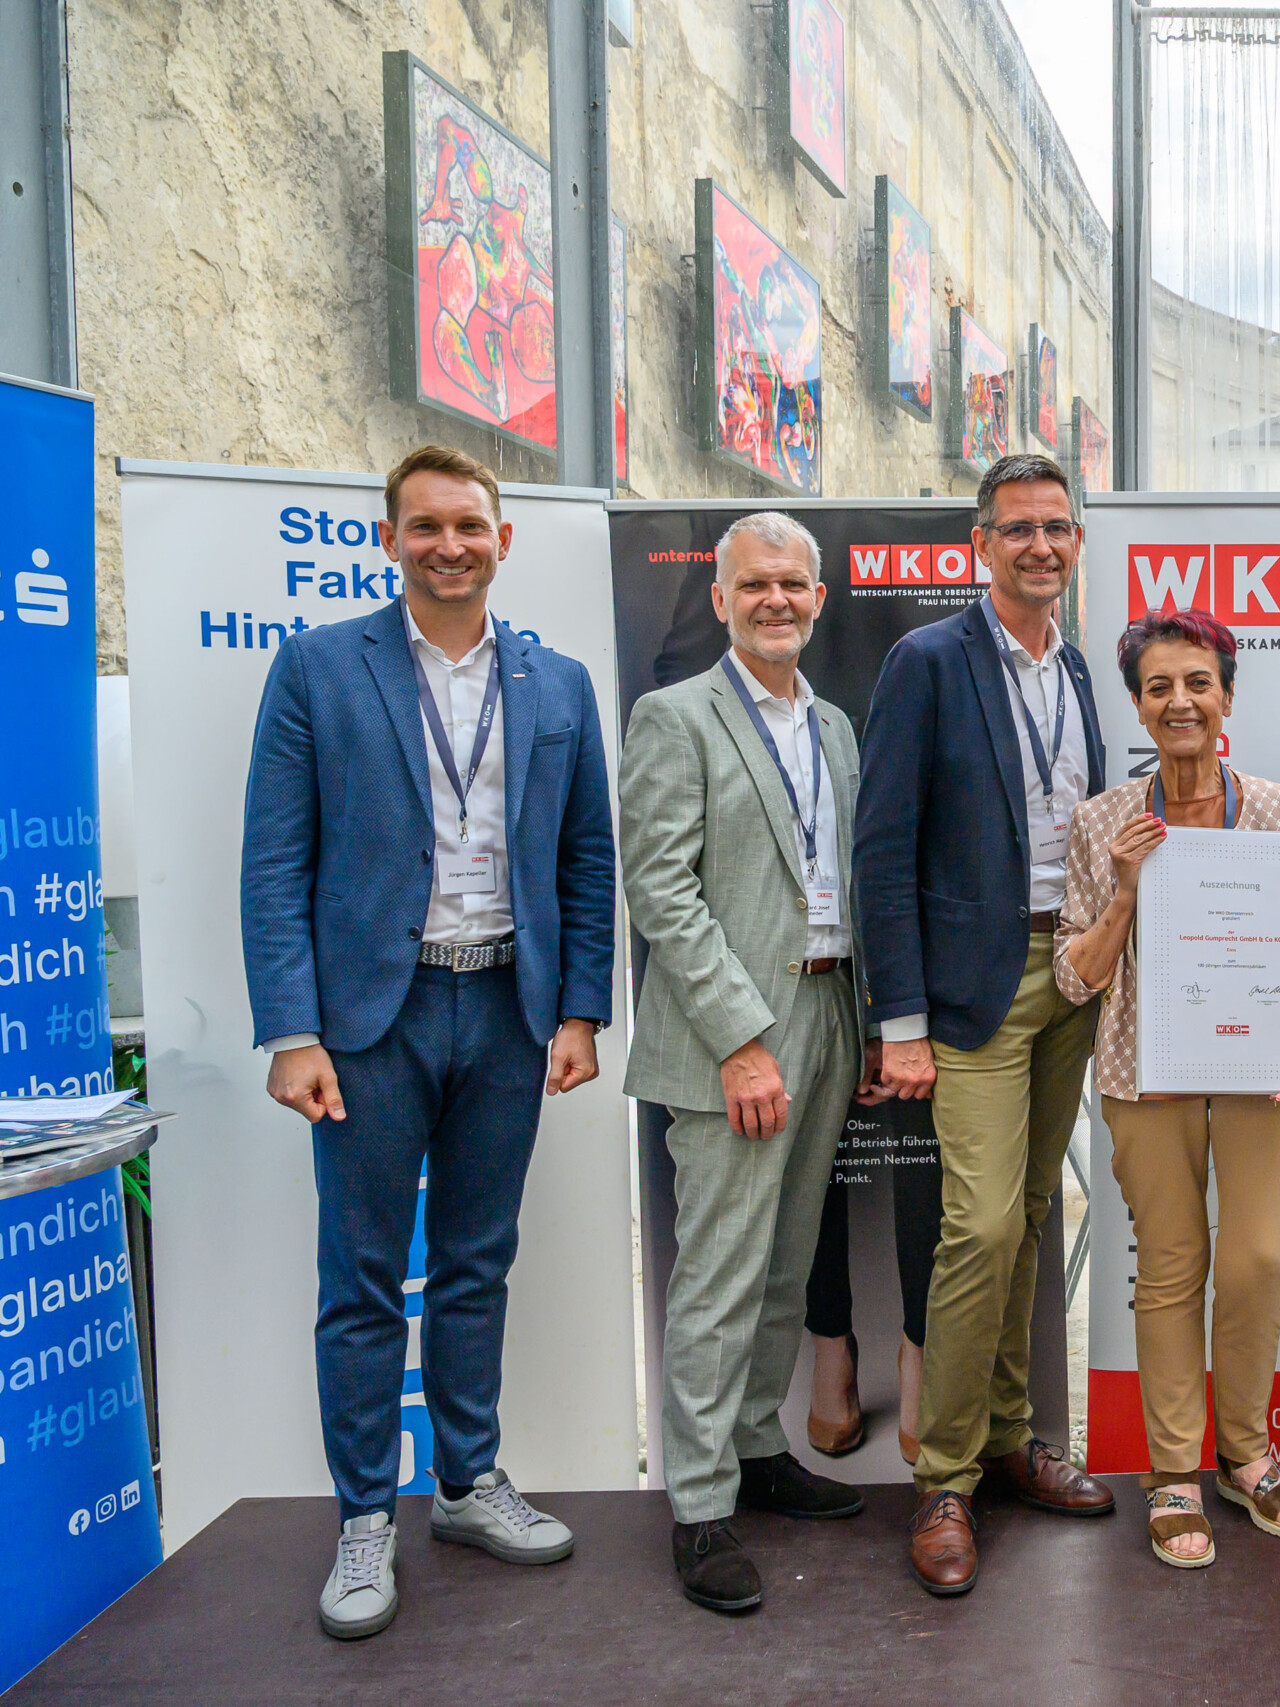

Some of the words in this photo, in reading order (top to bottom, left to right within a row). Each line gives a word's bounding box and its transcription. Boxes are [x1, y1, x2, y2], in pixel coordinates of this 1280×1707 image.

[853, 549, 967, 579] WKO
[286, 560, 405, 600] Fakt
[851, 589, 942, 597] WIRTSCHAFTSKAMMER
[918, 598, 938, 606] FRAU
[940, 598, 949, 606] IN
[951, 598, 965, 606] DER
[1199, 880, 1261, 892] Auszeichnung
[1179, 934, 1204, 942] Leopold
[1205, 934, 1238, 942] Gumprecht
[1216, 1024, 1241, 1034] WKO
[847, 1120, 881, 1131] Ober-
[852, 1137, 899, 1149] Betriebe
[903, 1135, 939, 1147] führen
[834, 1157, 881, 1166] unserem
[884, 1153, 937, 1165] Netzwerk
[836, 1173, 872, 1184] Punkt.
